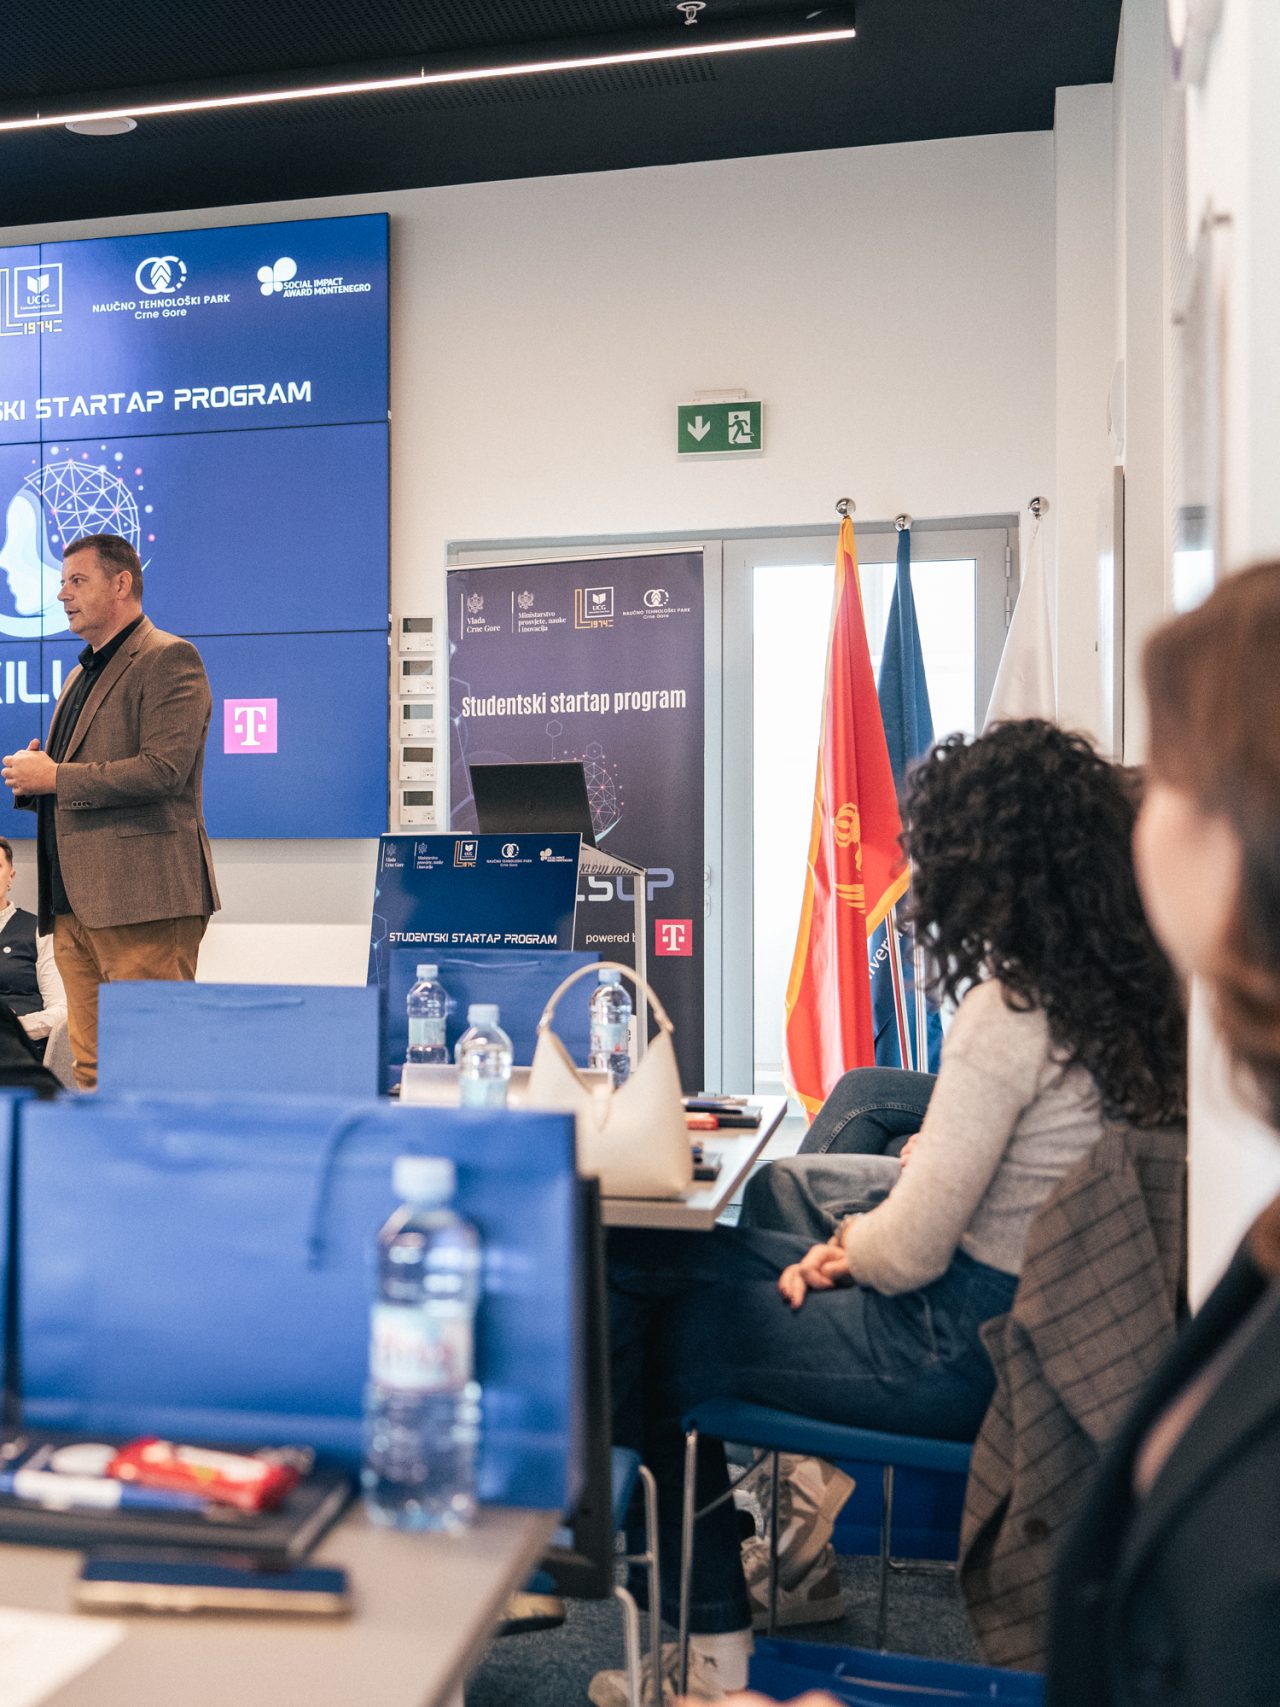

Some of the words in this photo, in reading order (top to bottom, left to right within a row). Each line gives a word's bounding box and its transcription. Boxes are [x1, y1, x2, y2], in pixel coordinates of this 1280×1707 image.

[283, 280, 312, 289] SOCIAL
[314, 277, 343, 287] IMPACT
[283, 287, 312, 298] AWARD
[314, 283, 371, 296] MONTENEGRO
[26, 294, 50, 305] UCG
[92, 300, 136, 313] NAUČNO
[139, 295, 201, 309] TEHNOLOŠKI
[203, 293, 230, 305] PARK
[134, 309, 159, 320] Crne
[162, 307, 187, 318] Gore
[35, 390, 164, 419] STARTAP
[174, 380, 312, 410] PROGRAM
[466, 617, 486, 625] Vlada
[518, 611, 556, 619] Ministarstvo
[461, 692, 547, 717] Studentski
[550, 692, 610, 715] startap
[614, 689, 686, 714] program
[234, 706, 267, 746] T
[389, 932, 449, 943] STUDENTSKI
[451, 933, 501, 944] STARTAP
[504, 934, 558, 945] PROGRAM
[585, 933, 630, 944] powered
[662, 924, 685, 951] T
